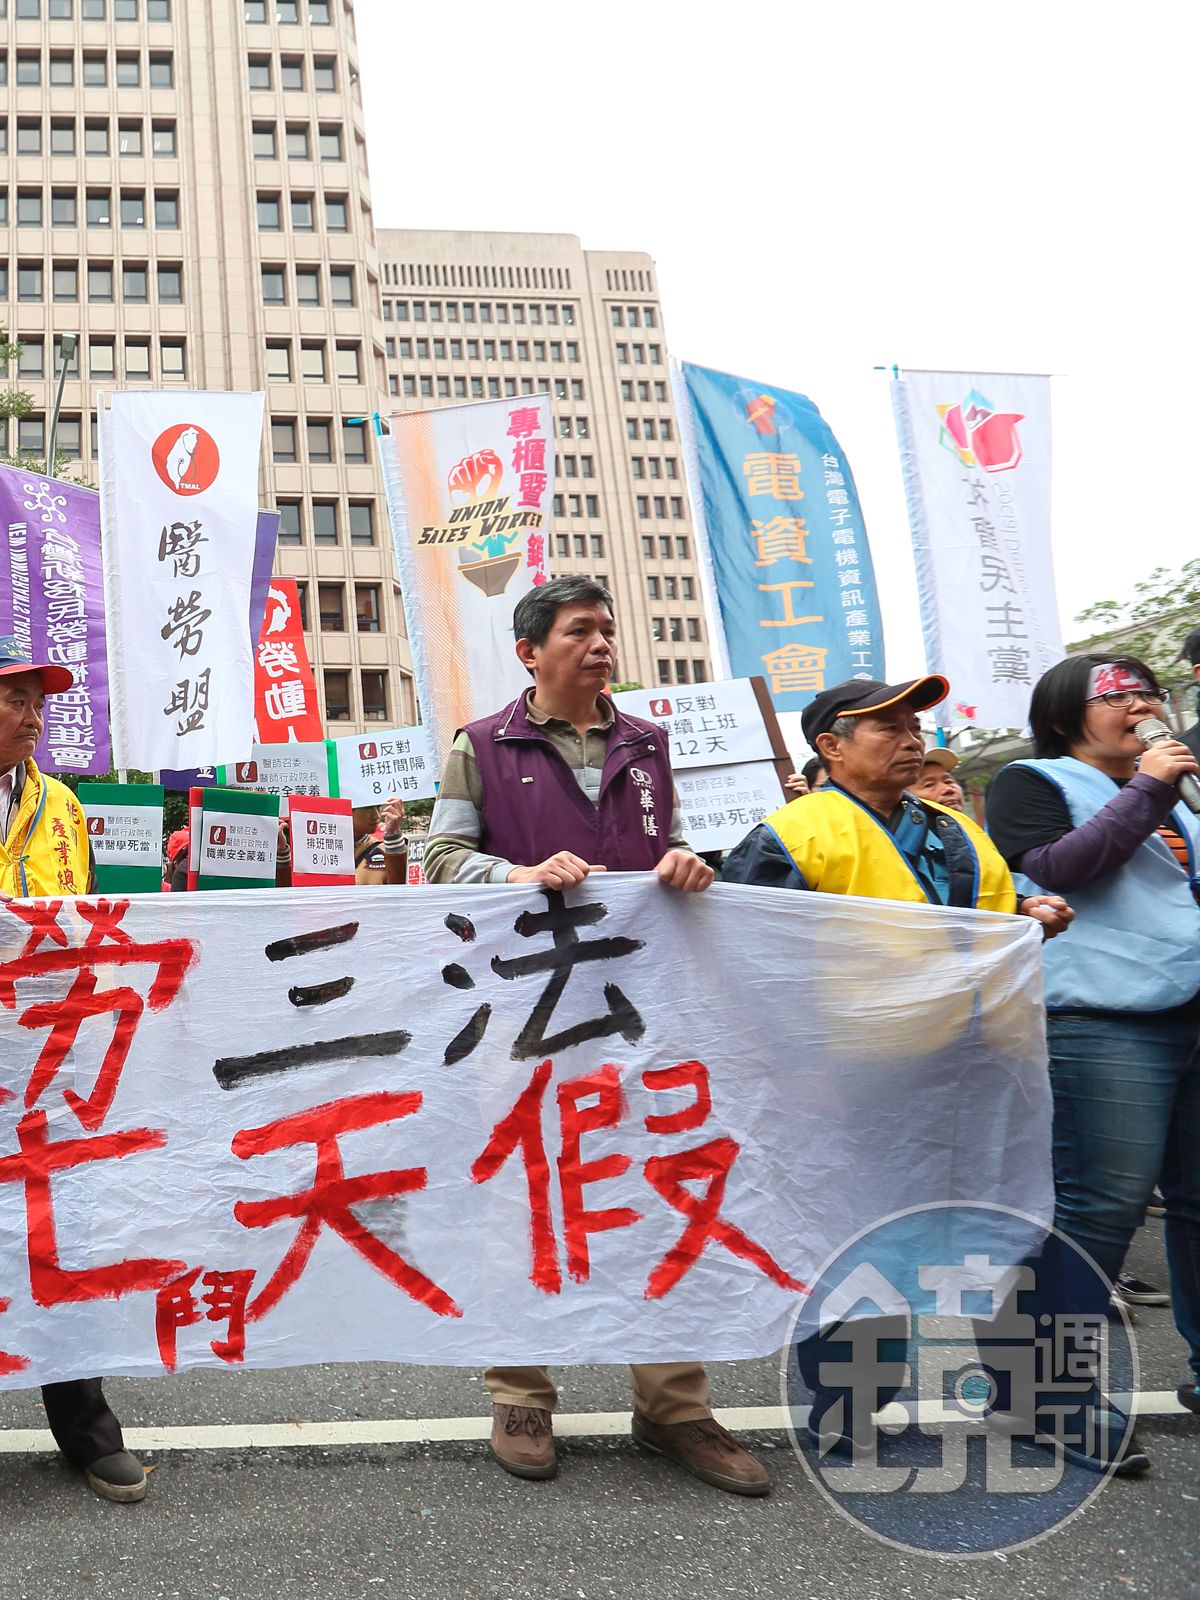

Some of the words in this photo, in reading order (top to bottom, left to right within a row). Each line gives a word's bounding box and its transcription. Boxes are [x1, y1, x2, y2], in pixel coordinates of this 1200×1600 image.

[450, 496, 510, 524] UNION
[418, 525, 471, 545] SALES
[742, 451, 828, 694] 電資工會
[157, 519, 212, 738] 醫勞盟
[676, 694, 716, 714] 反對
[380, 739, 411, 757] 反對
[360, 755, 425, 778] 排班間隔
[259, 771, 319, 783] 醫師行政院長
[319, 822, 337, 836] 反對
[306, 837, 344, 852] 排班間隔
